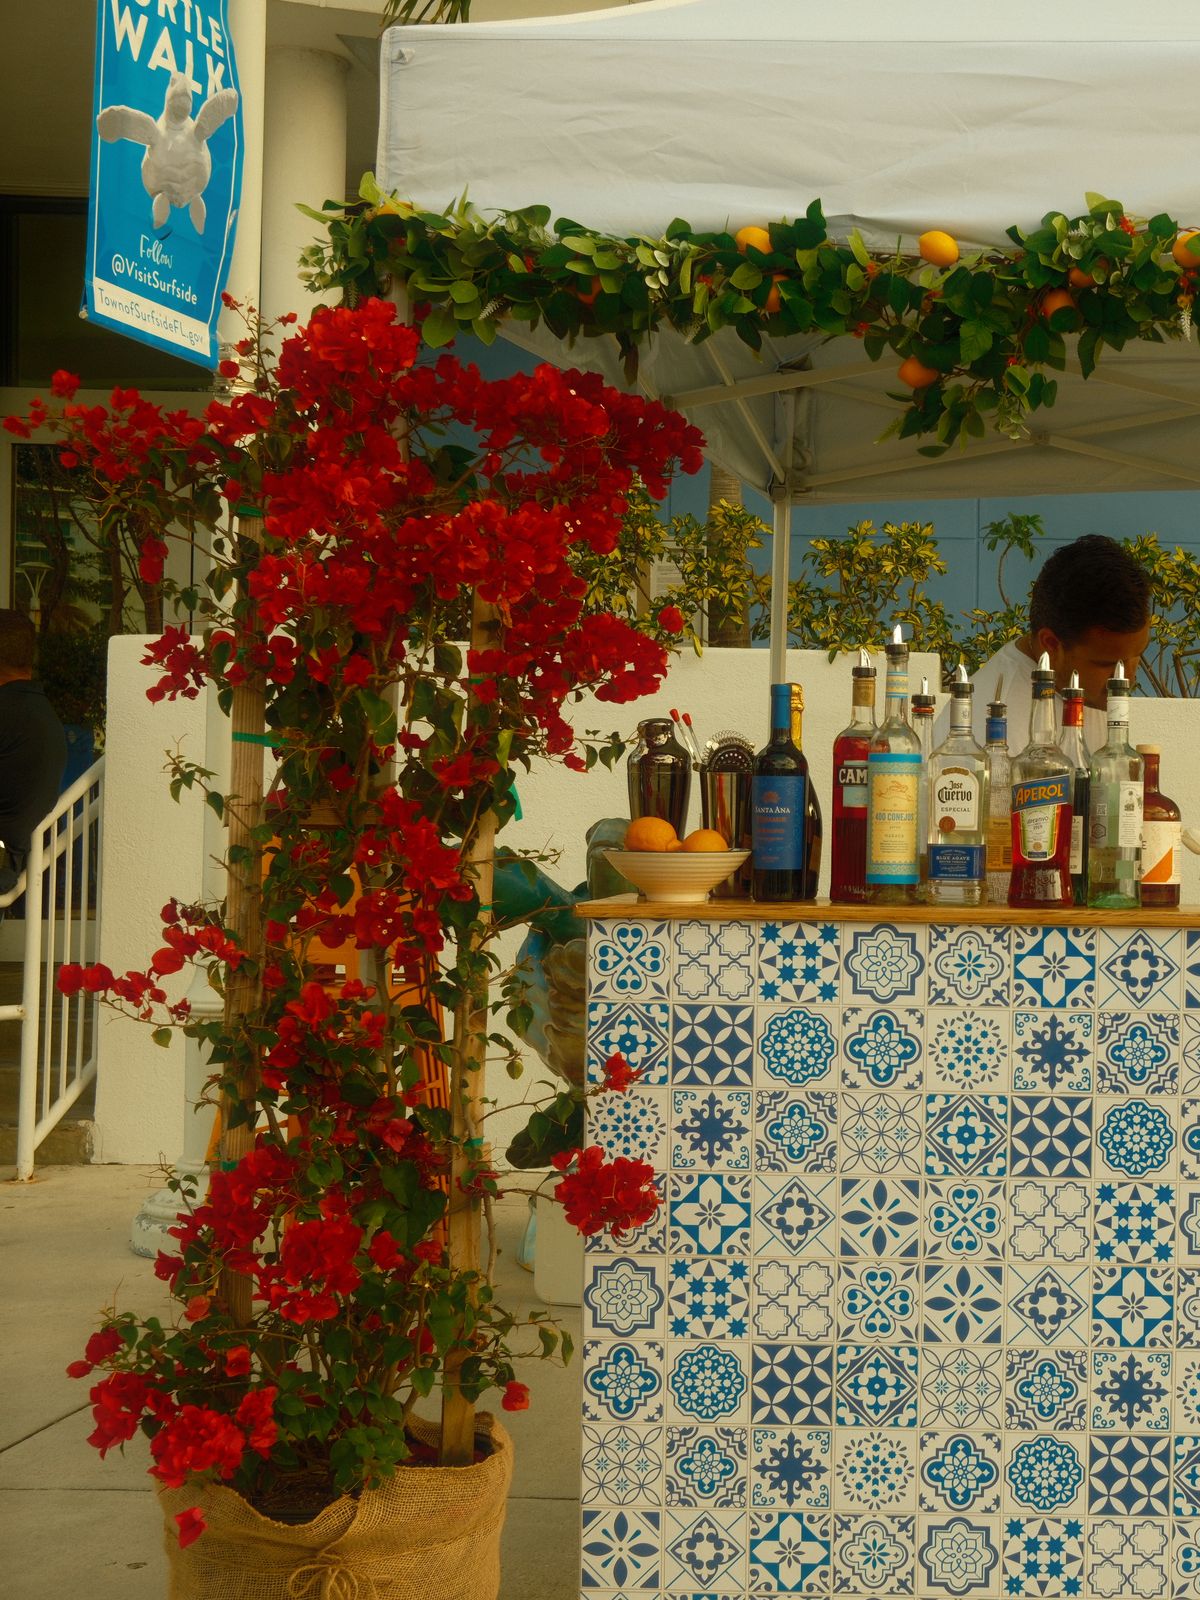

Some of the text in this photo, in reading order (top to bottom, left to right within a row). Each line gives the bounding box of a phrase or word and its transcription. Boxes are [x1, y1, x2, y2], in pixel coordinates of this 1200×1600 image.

[111, 0, 225, 100] WALK
[140, 234, 173, 269] Follow
[112, 254, 198, 305] @VisitSurfside
[98, 287, 203, 346] TownofSurfsideFL.gov
[838, 768, 868, 784] CAM
[938, 786, 972, 803] Cuervo
[1015, 783, 1063, 807] APEROL
